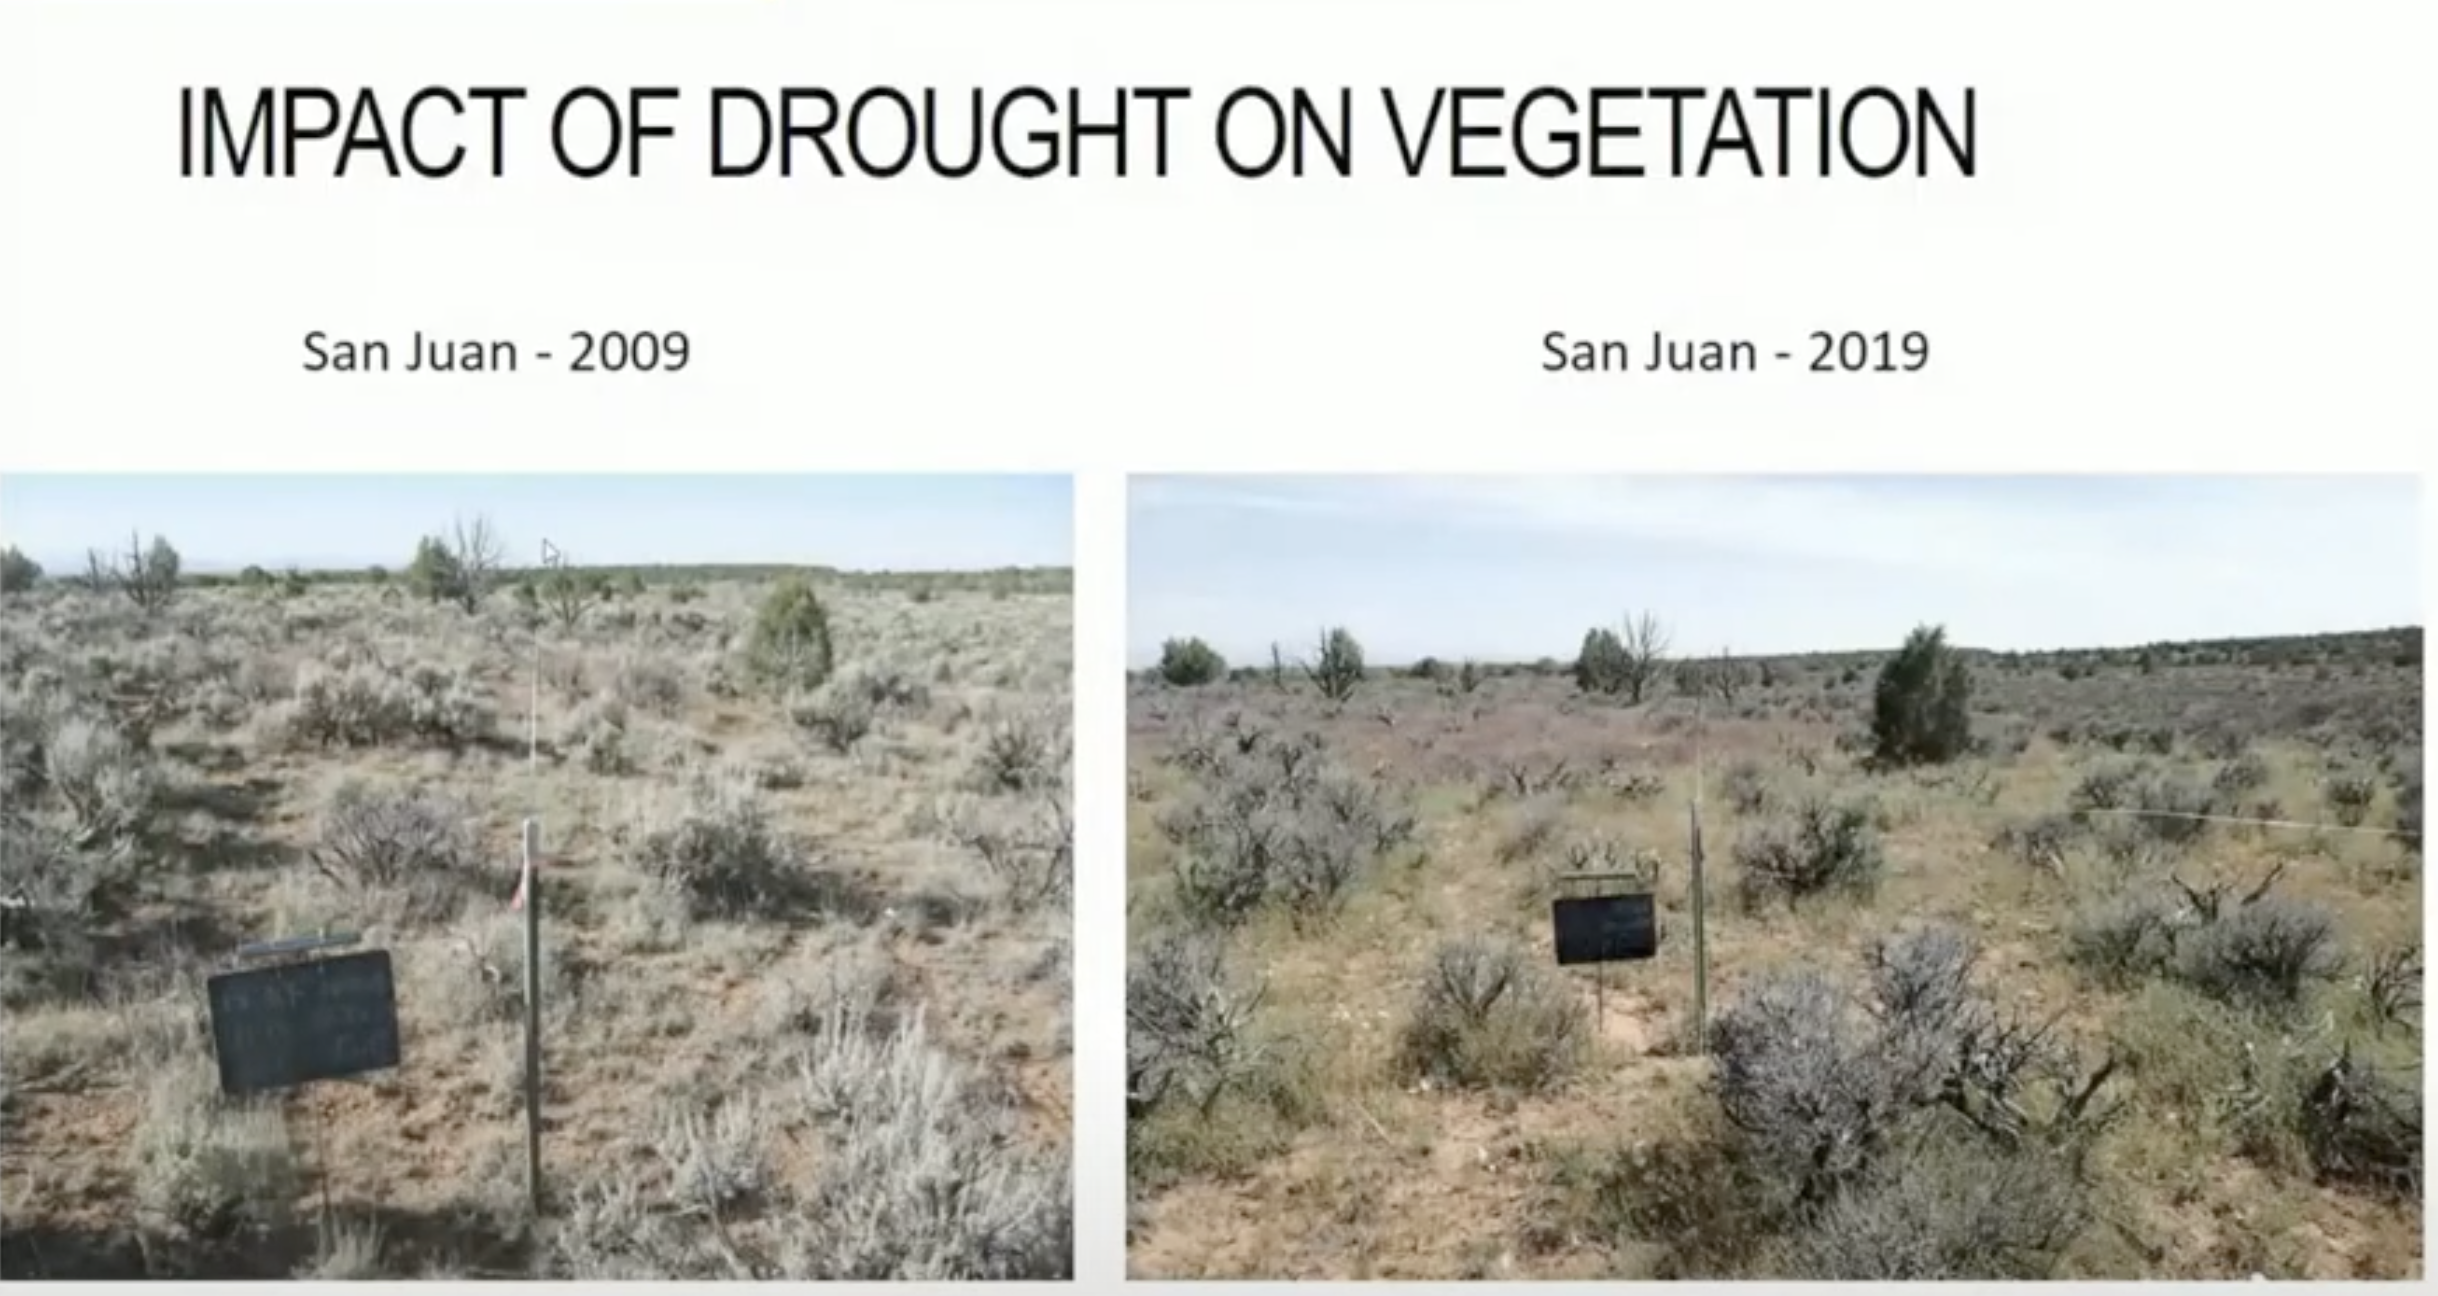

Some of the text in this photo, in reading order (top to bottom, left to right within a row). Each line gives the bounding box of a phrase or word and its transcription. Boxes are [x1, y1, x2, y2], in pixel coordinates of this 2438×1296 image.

[181, 85, 1976, 179] IMPACT OF DROUGHT ON VEGETATION
[302, 331, 389, 373] San
[405, 331, 516, 373] Juan
[569, 330, 691, 373] 2009
[1541, 331, 1628, 373] San
[1645, 331, 1756, 373] Juan
[1809, 330, 1930, 373] 2019
